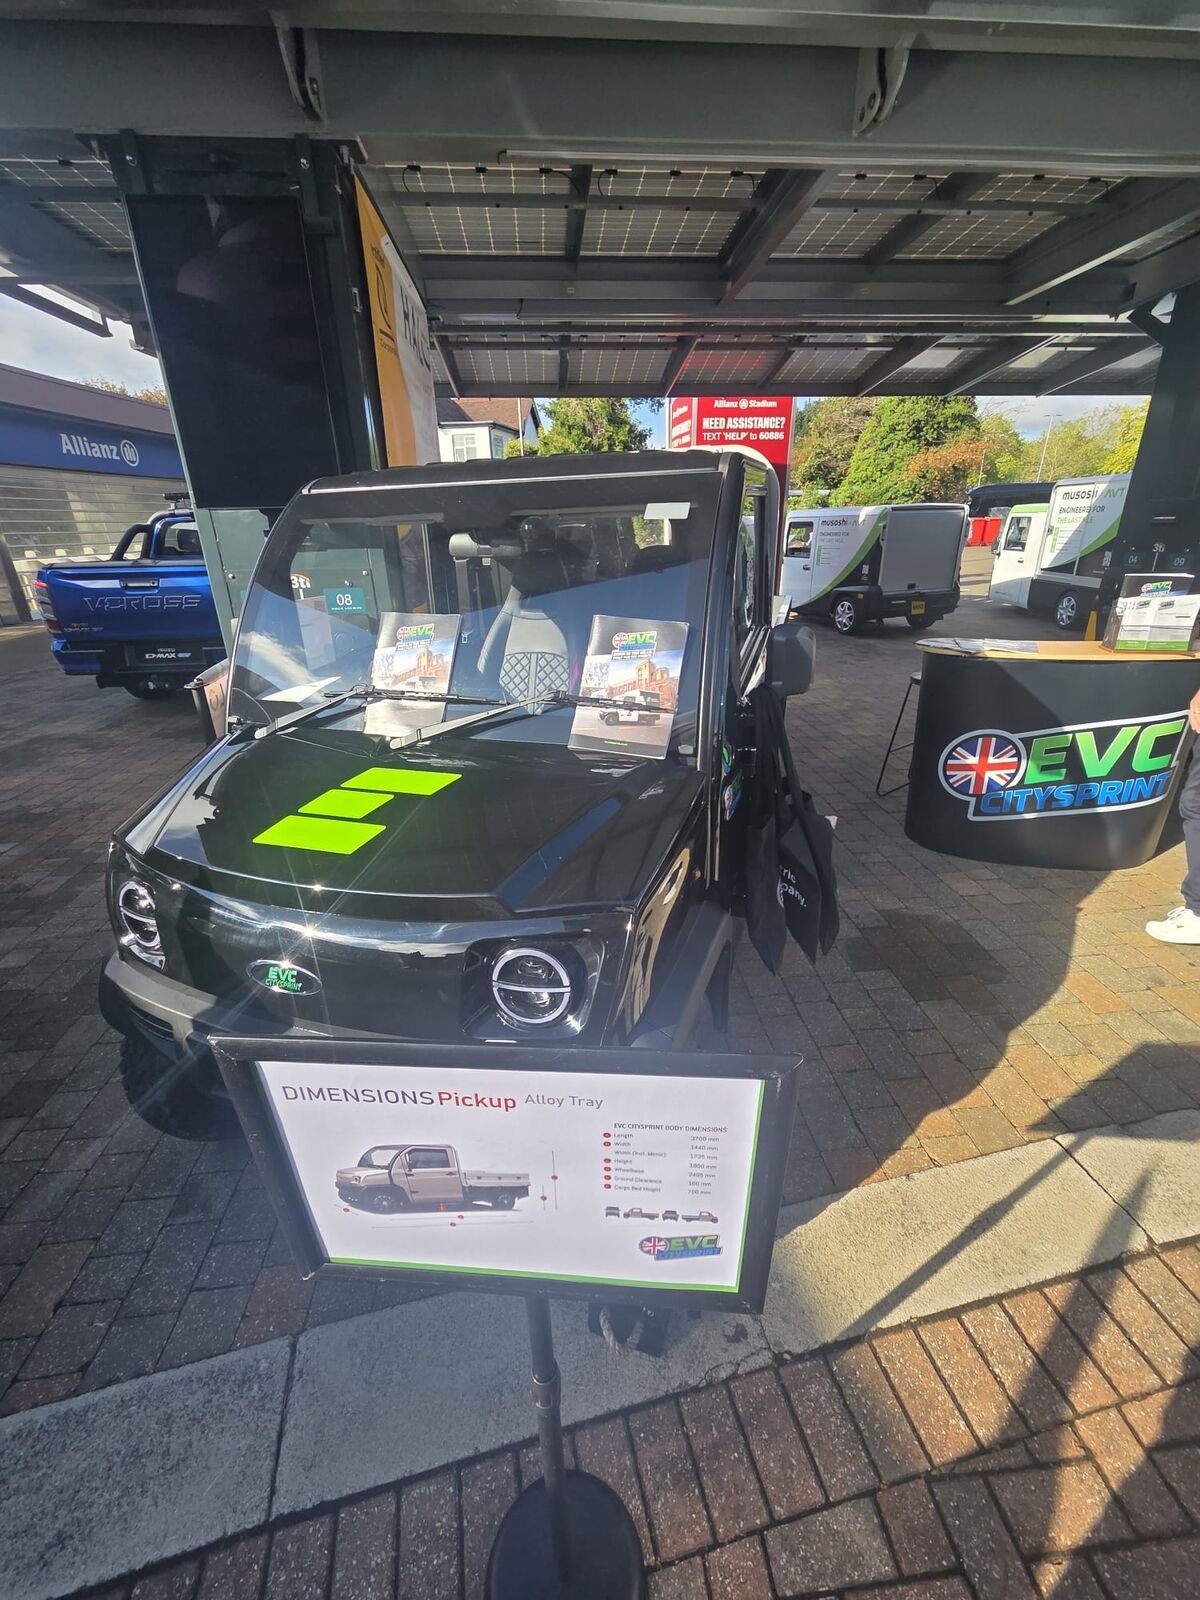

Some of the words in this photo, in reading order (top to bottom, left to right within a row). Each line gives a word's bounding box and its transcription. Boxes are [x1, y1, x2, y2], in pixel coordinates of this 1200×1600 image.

[714, 400, 738, 408] Allianz
[749, 400, 777, 408] Stadium
[702, 417, 725, 429] NEED
[726, 417, 785, 429] ASSISTANCE?
[703, 432, 721, 440] TEXT
[759, 432, 784, 440] 60886
[59, 433, 120, 460] Allianz
[1092, 505, 1106, 513] FOR
[821, 518, 848, 527] musoshi
[1128, 555, 1138, 564] 04
[1174, 558, 1185, 566] 09
[336, 594, 353, 606] 08
[627, 632, 655, 645] EVC
[1023, 718, 1186, 785] EVC
[979, 769, 1174, 814] CITYSPRINT
[268, 966, 298, 983] EVC
[281, 1085, 435, 1105] DIMENSIONS
[437, 1091, 517, 1112] Pickup
[524, 1094, 564, 1108] Alloy
[568, 1095, 604, 1109] Tray
[685, 1125, 728, 1133] DIMENSIONS
[614, 1132, 634, 1140] Length
[670, 1236, 717, 1251] EVC
